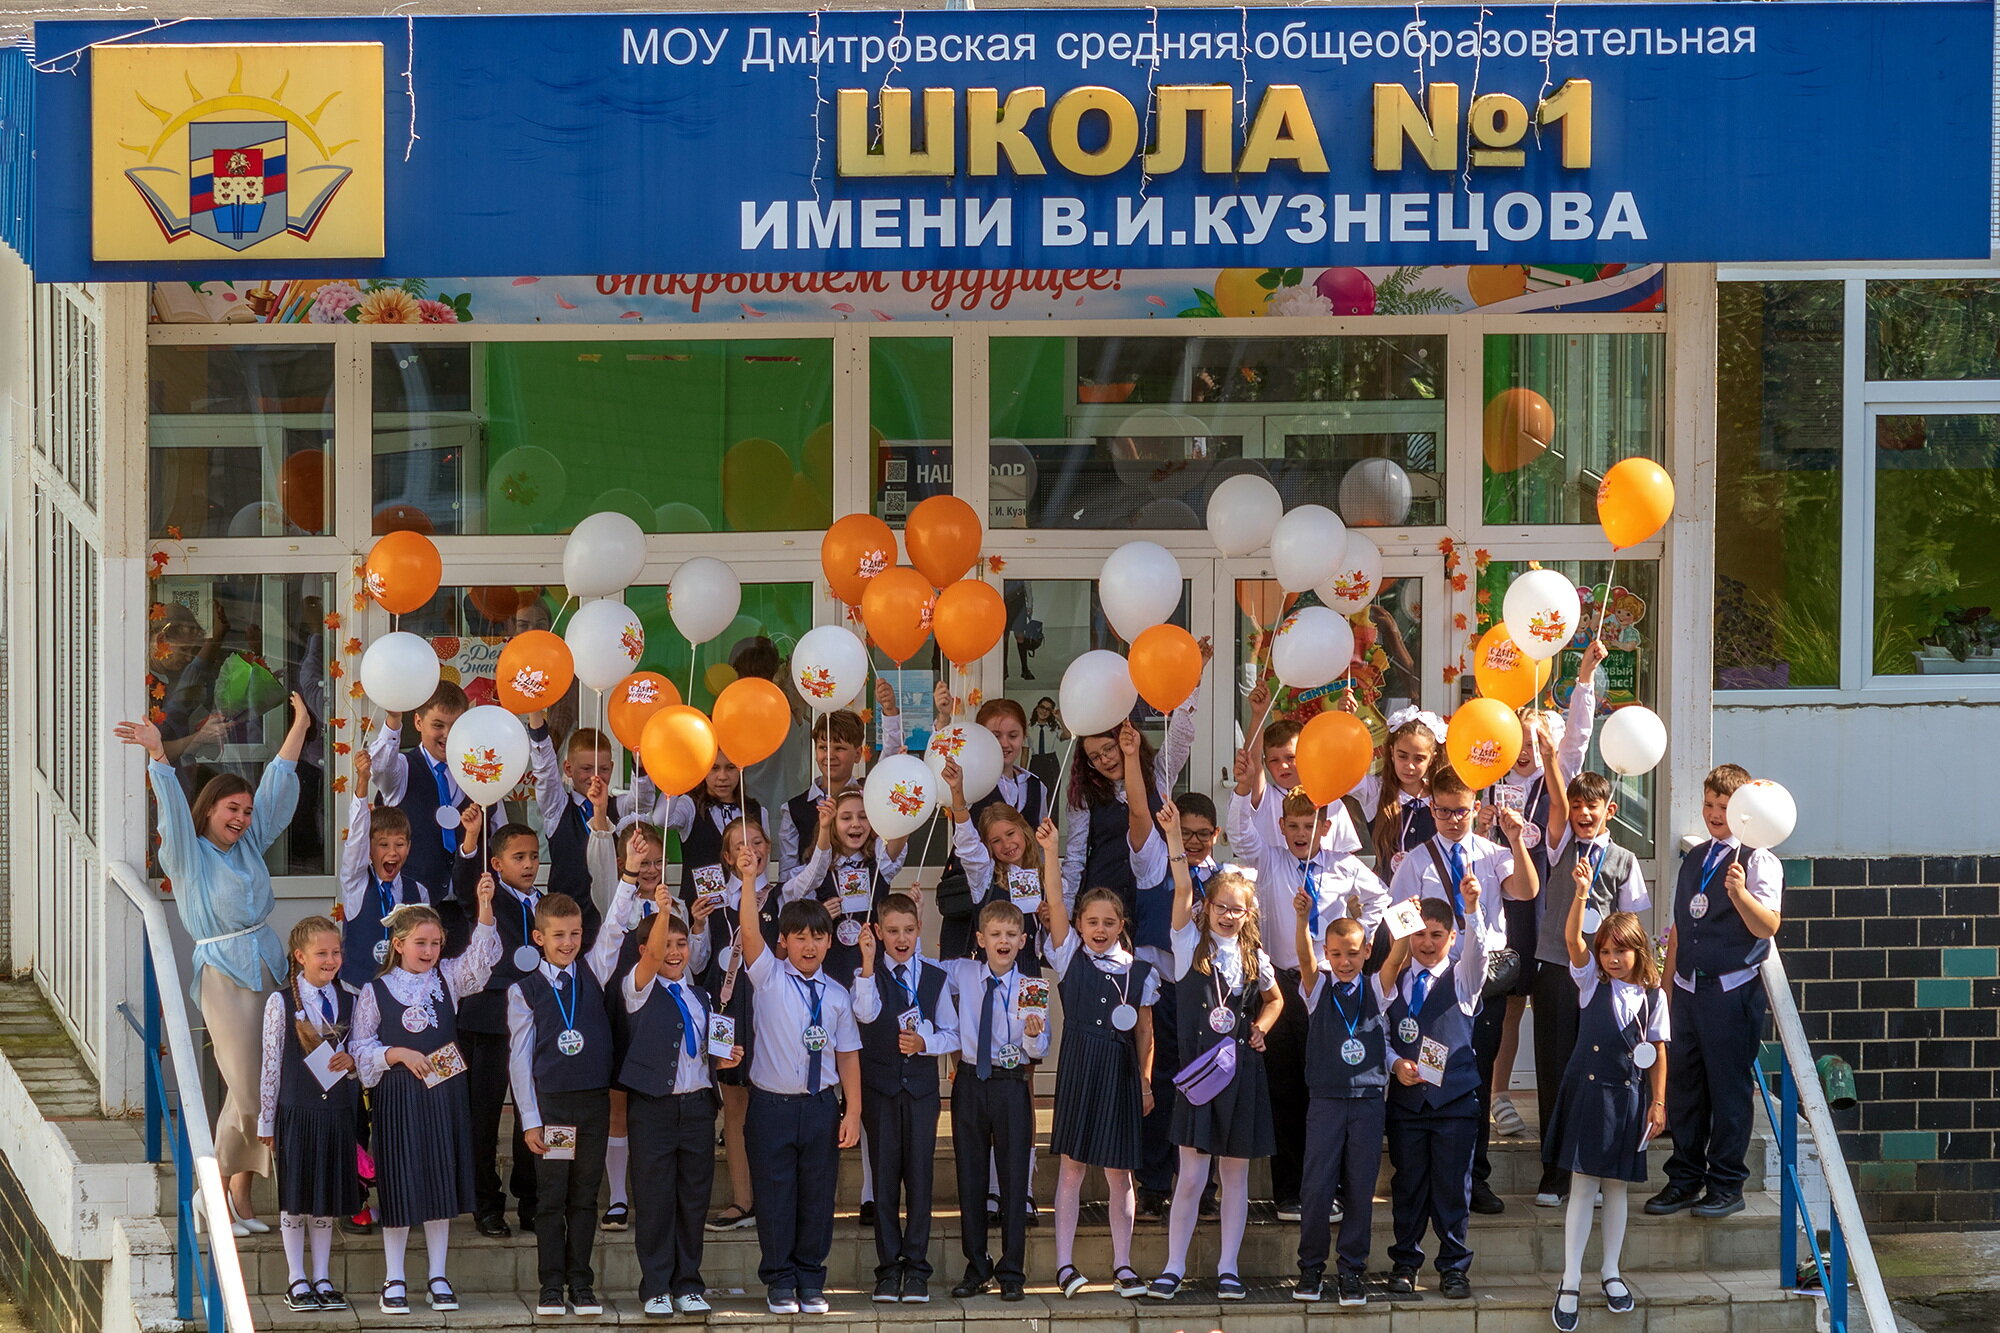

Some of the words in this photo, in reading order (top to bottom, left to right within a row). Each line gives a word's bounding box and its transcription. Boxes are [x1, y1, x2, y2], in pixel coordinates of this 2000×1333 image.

[622, 27, 729, 65] МОУ
[741, 27, 1036, 72] Дмитровская
[1056, 29, 1239, 69] средняя
[1255, 20, 1757, 67] общеобразовательная
[837, 84, 1331, 177] ШКОЛА
[1373, 78, 1592, 172] №1
[741, 197, 1012, 250] ИМЕНИ
[1042, 190, 1648, 251] В.И.КУЗНЕЦОВА
[470, 644, 502, 660] Де
